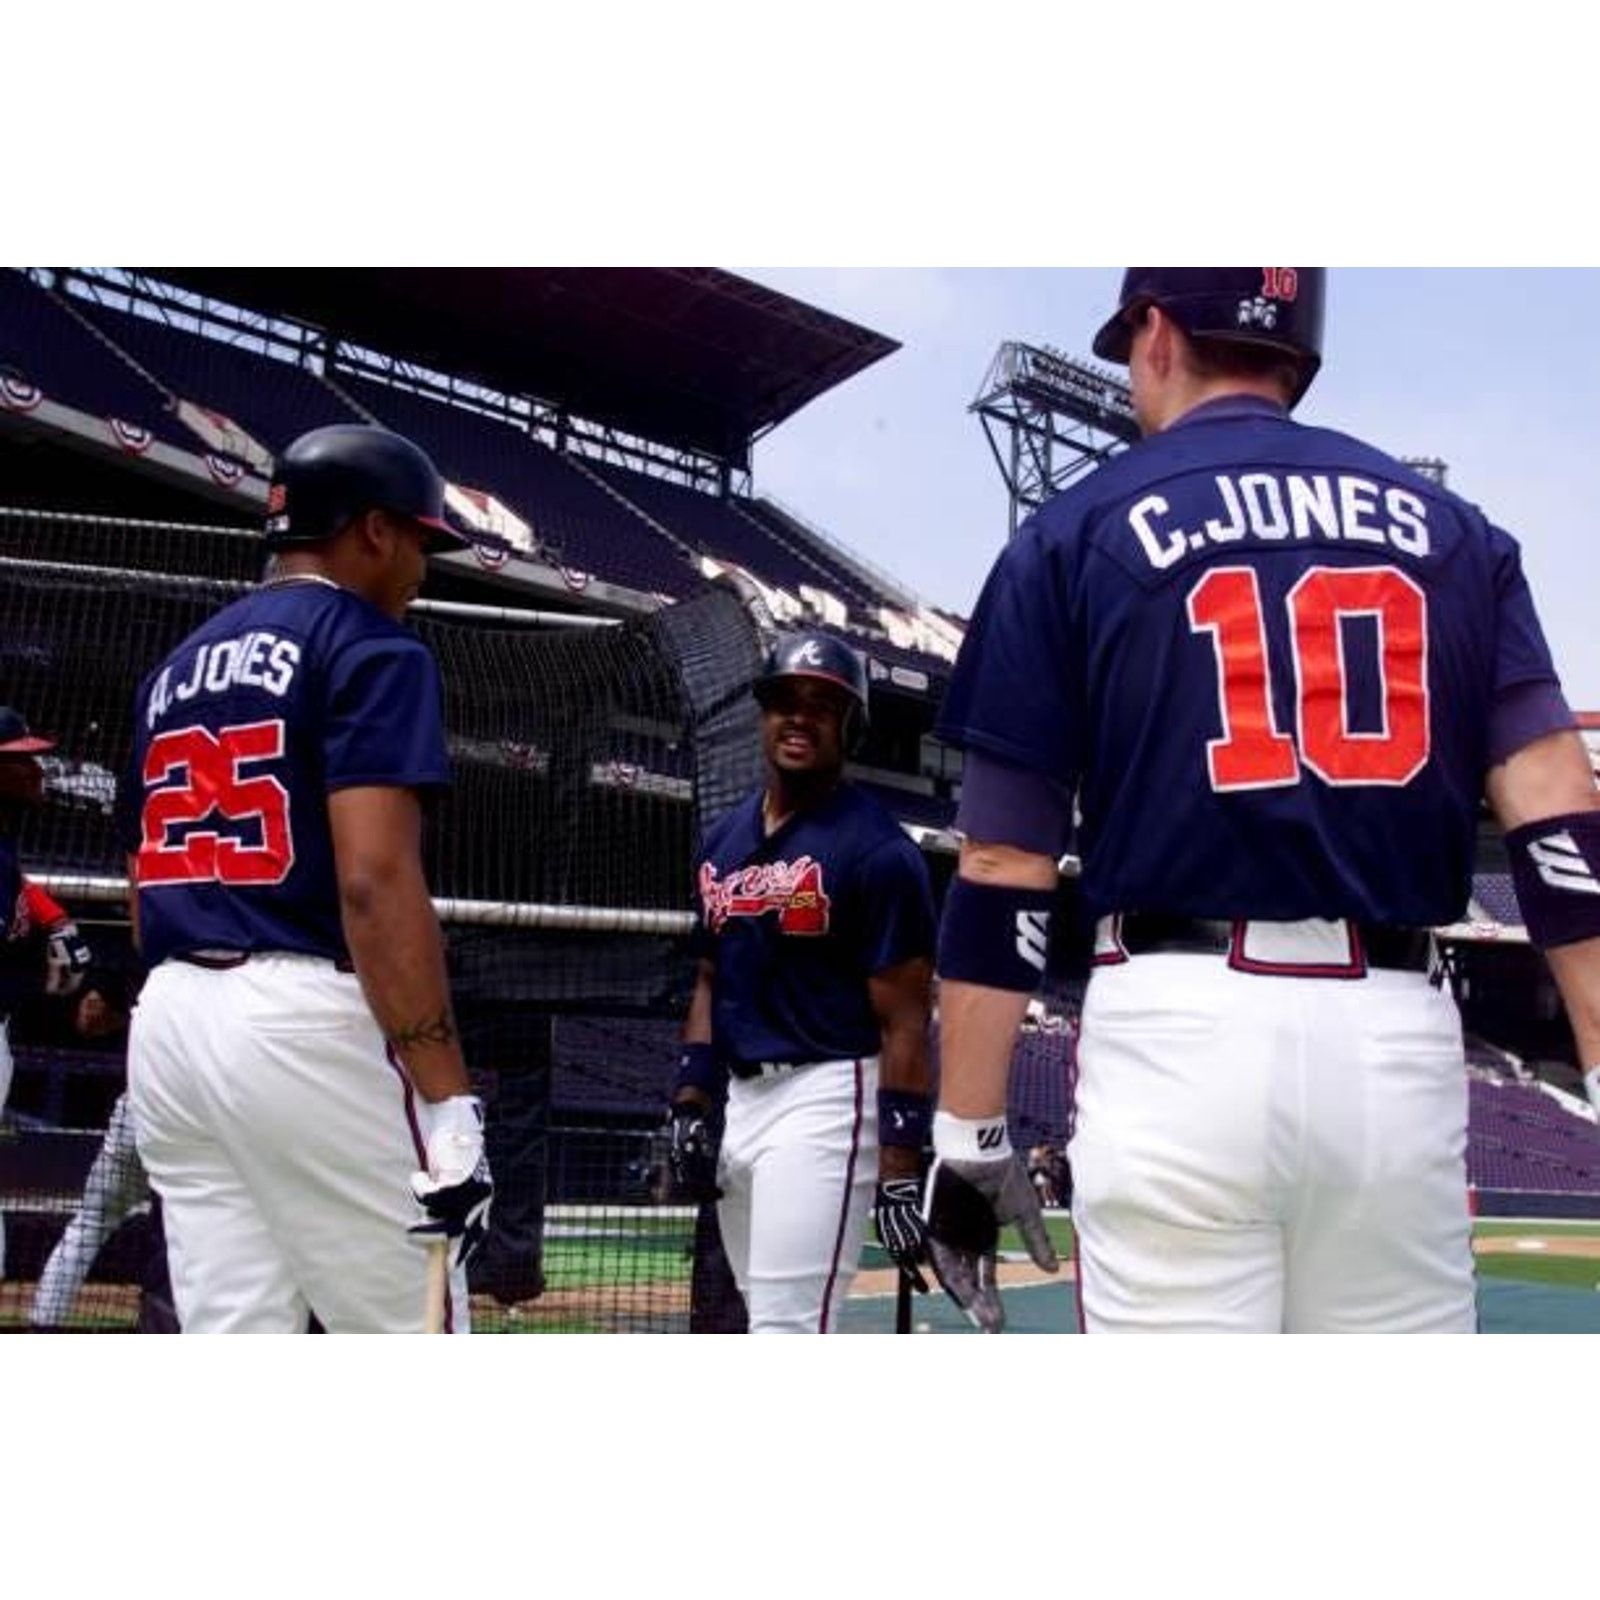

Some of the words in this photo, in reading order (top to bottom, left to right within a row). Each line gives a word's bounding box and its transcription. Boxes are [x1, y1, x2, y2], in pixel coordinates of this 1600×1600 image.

[1262, 267, 1298, 301] 10
[1128, 473, 1430, 569] C.JONES
[1186, 565, 1430, 792] 10
[136, 718, 296, 887] 25
